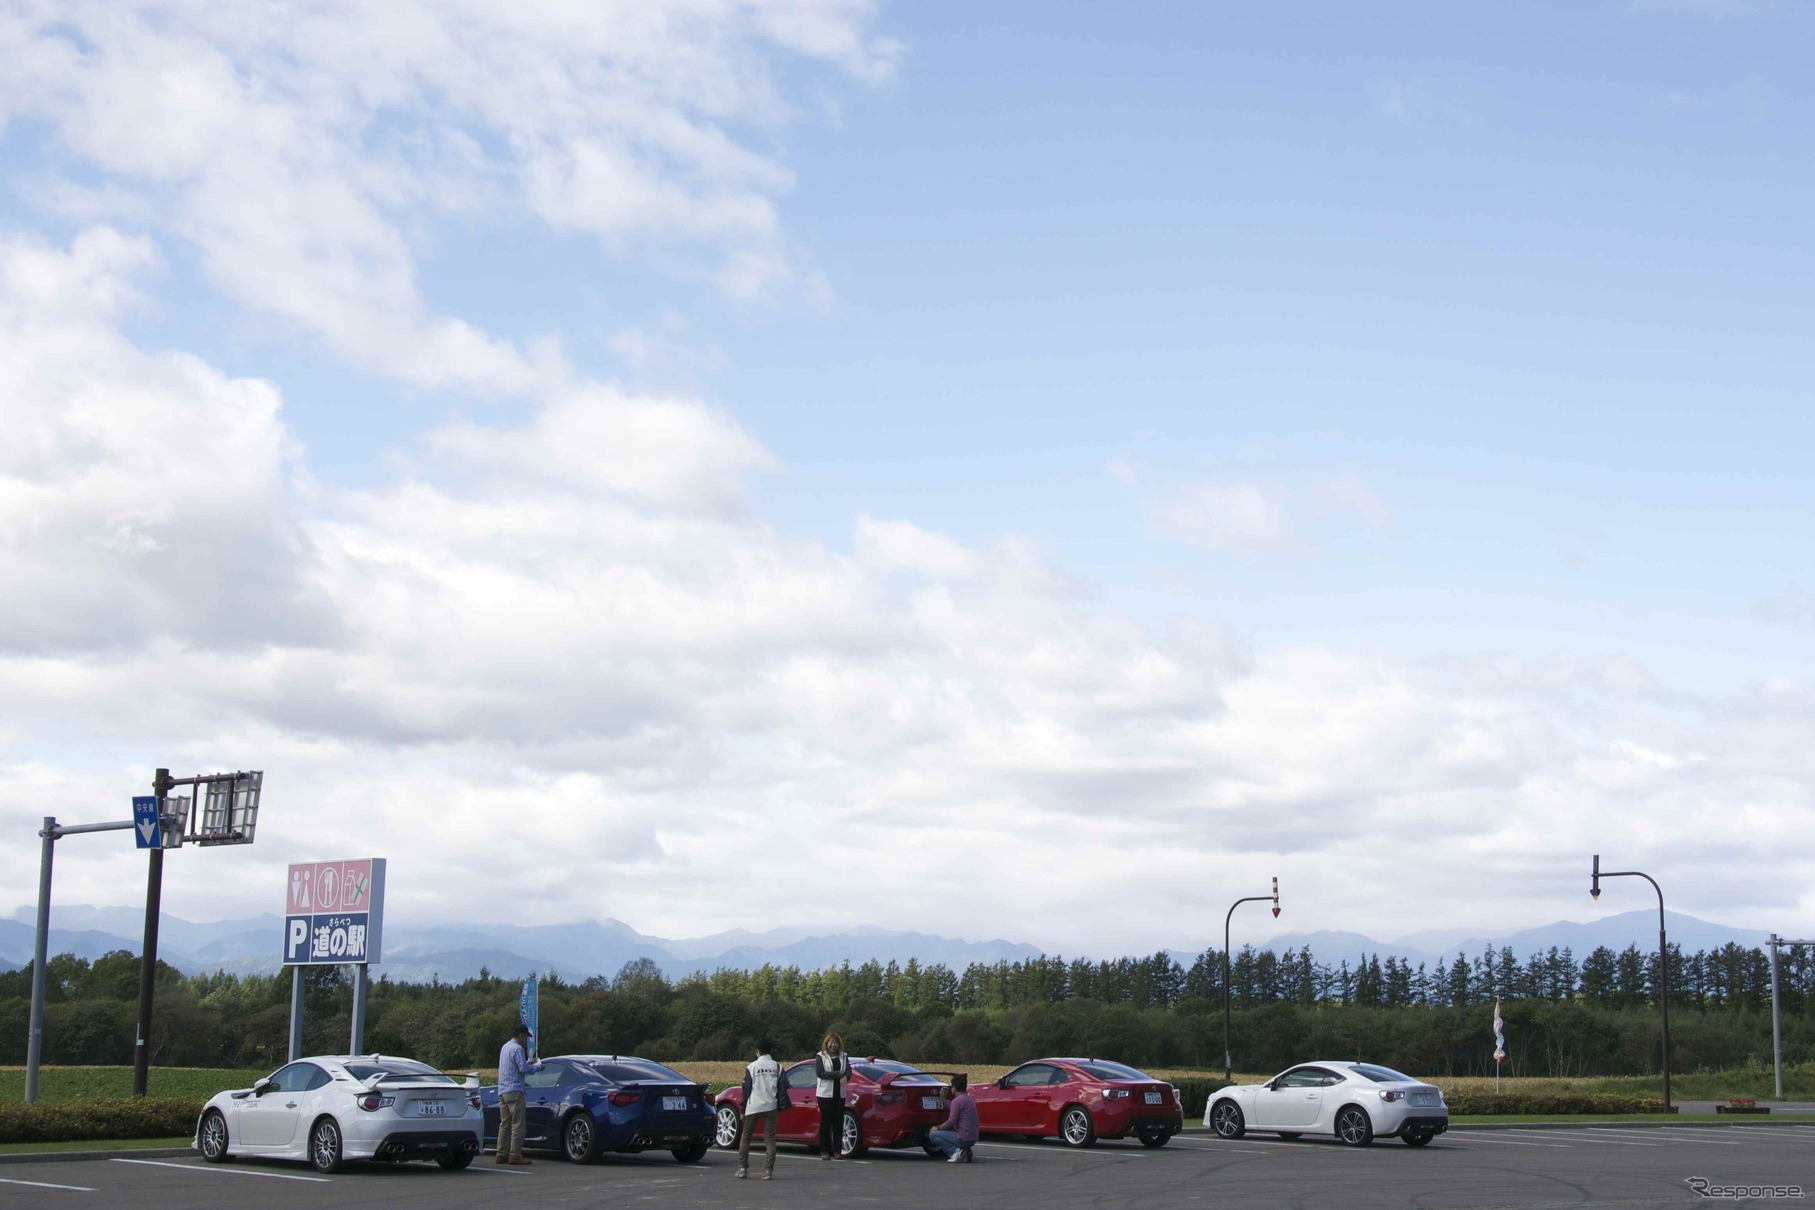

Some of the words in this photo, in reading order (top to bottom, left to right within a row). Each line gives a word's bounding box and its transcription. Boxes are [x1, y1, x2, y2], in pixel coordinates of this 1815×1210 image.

[329, 917, 351, 927] さらべつ
[288, 919, 307, 959] P
[313, 924, 365, 957] 道の駅
